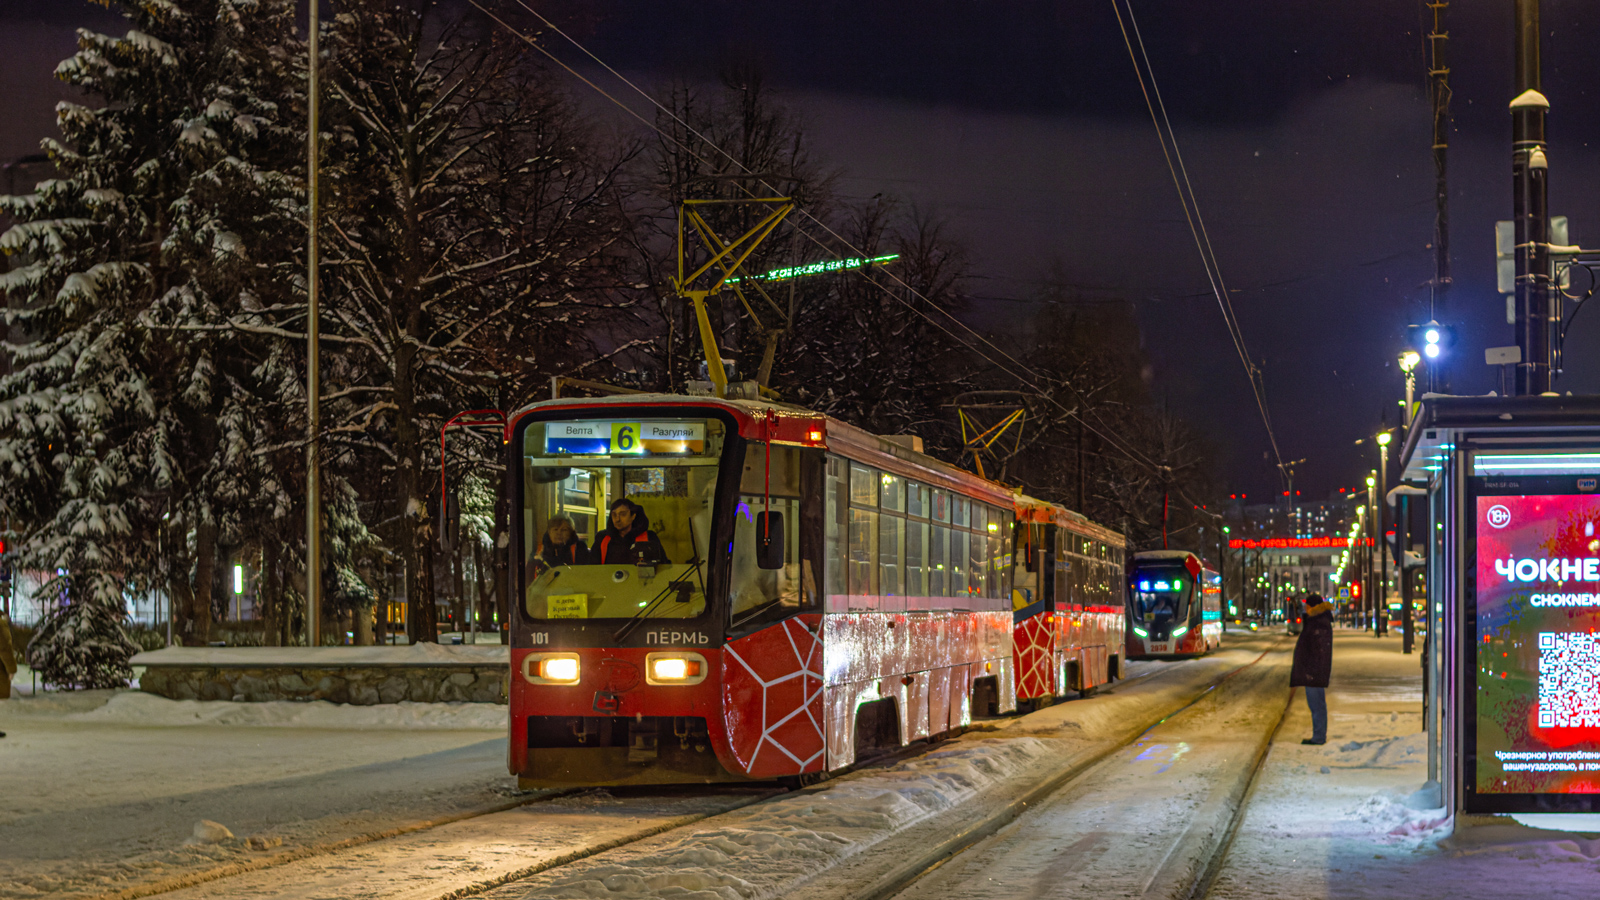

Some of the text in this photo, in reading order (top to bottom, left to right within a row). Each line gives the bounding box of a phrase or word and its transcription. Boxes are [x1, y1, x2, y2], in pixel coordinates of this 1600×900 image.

[566, 425, 694, 451] Велта 6 Разгуляй
[1491, 509, 1508, 523] 18+
[1288, 536, 1331, 548] ТРУДОВОЙ
[1494, 557, 1600, 583] ЧОКНЕ
[530, 631, 549, 645] 101
[646, 631, 709, 645] ПЕРМЬ
[1494, 750, 1547, 762] Чрезмерное
[1578, 763, 1584, 771] а
